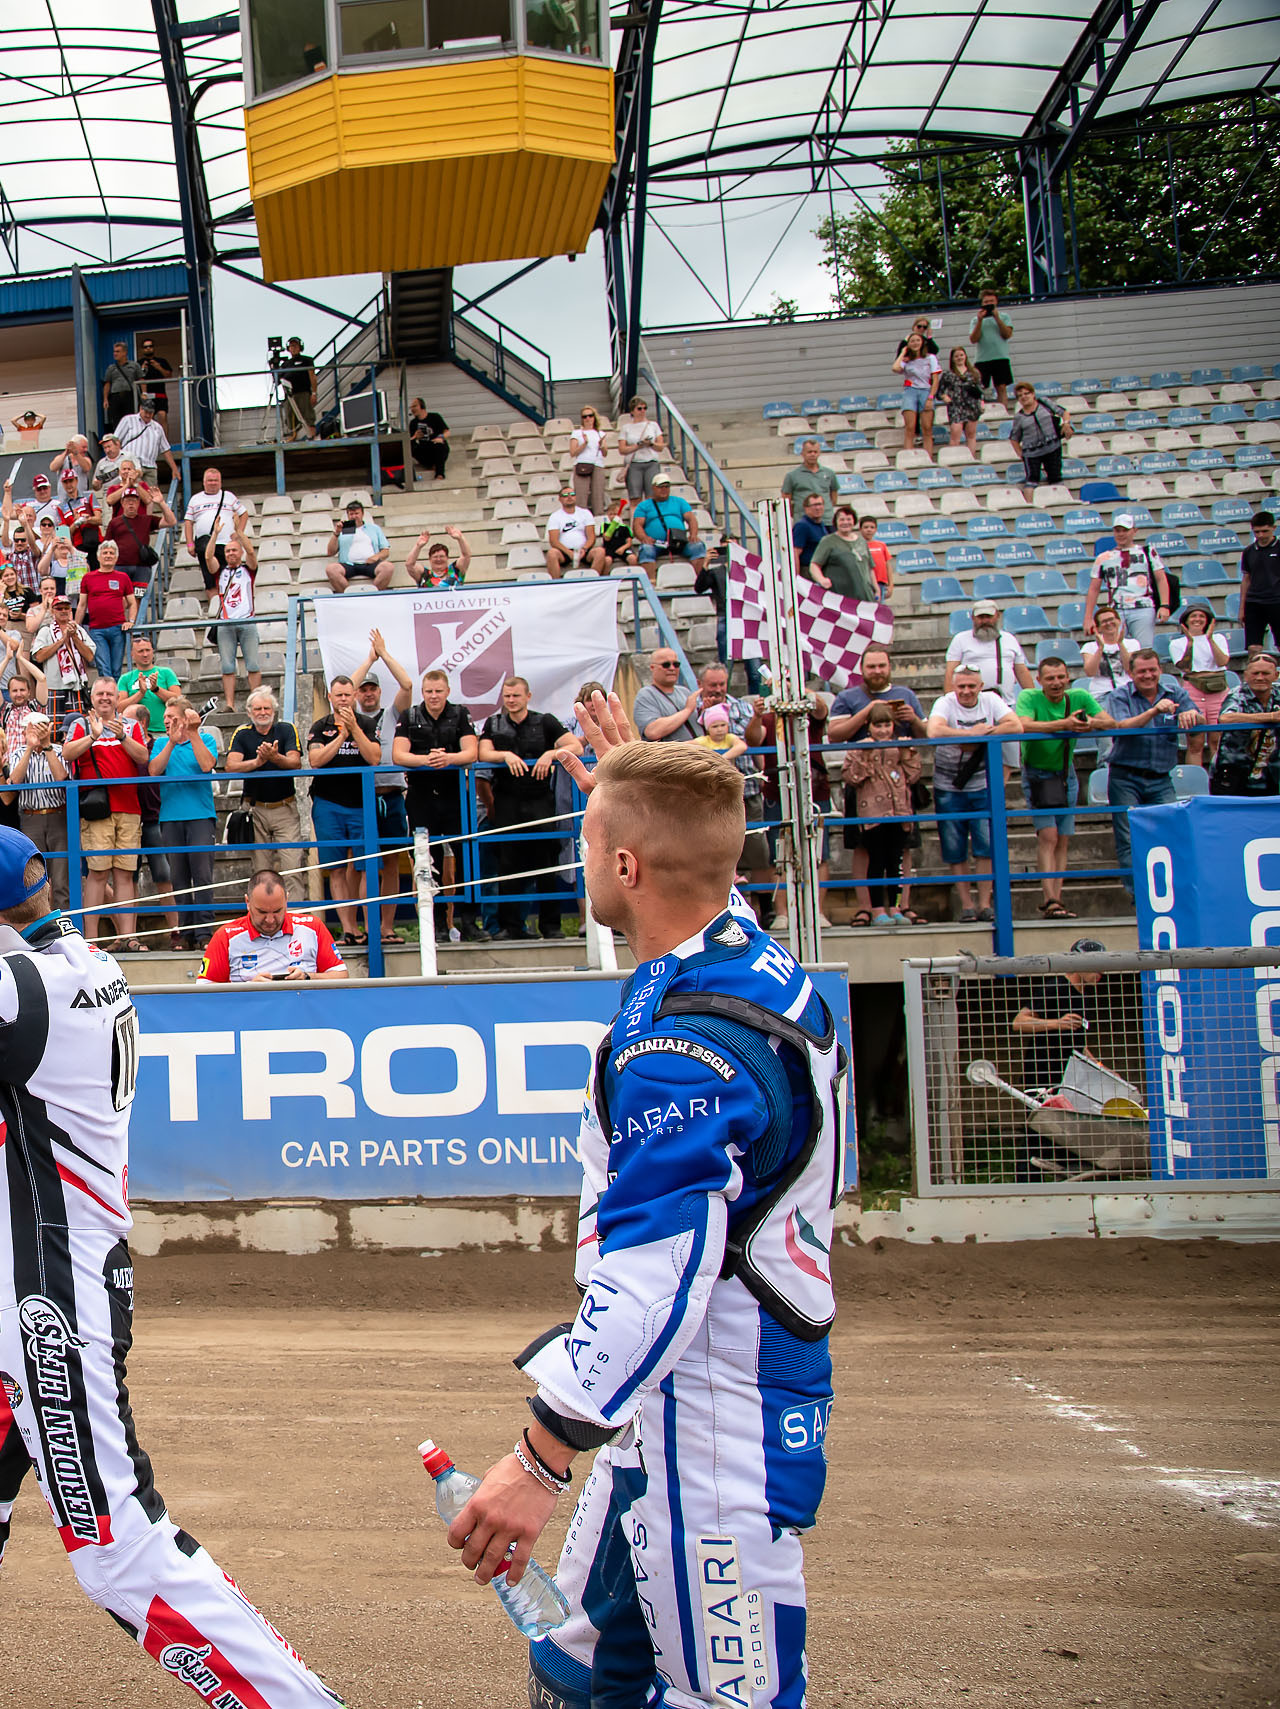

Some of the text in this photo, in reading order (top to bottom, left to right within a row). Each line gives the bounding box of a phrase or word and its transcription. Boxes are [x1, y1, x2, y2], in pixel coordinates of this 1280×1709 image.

[413, 596, 511, 612] DAUGAVPILS
[139, 1020, 608, 1122] TROD
[281, 1135, 581, 1168] CAR PARTS ONLIN
[36, 1321, 72, 1402] LIFTS
[42, 1410, 98, 1541] MERIDIAN
[703, 1538, 748, 1709] AGARI
[749, 1592, 767, 1686] SPORTS
